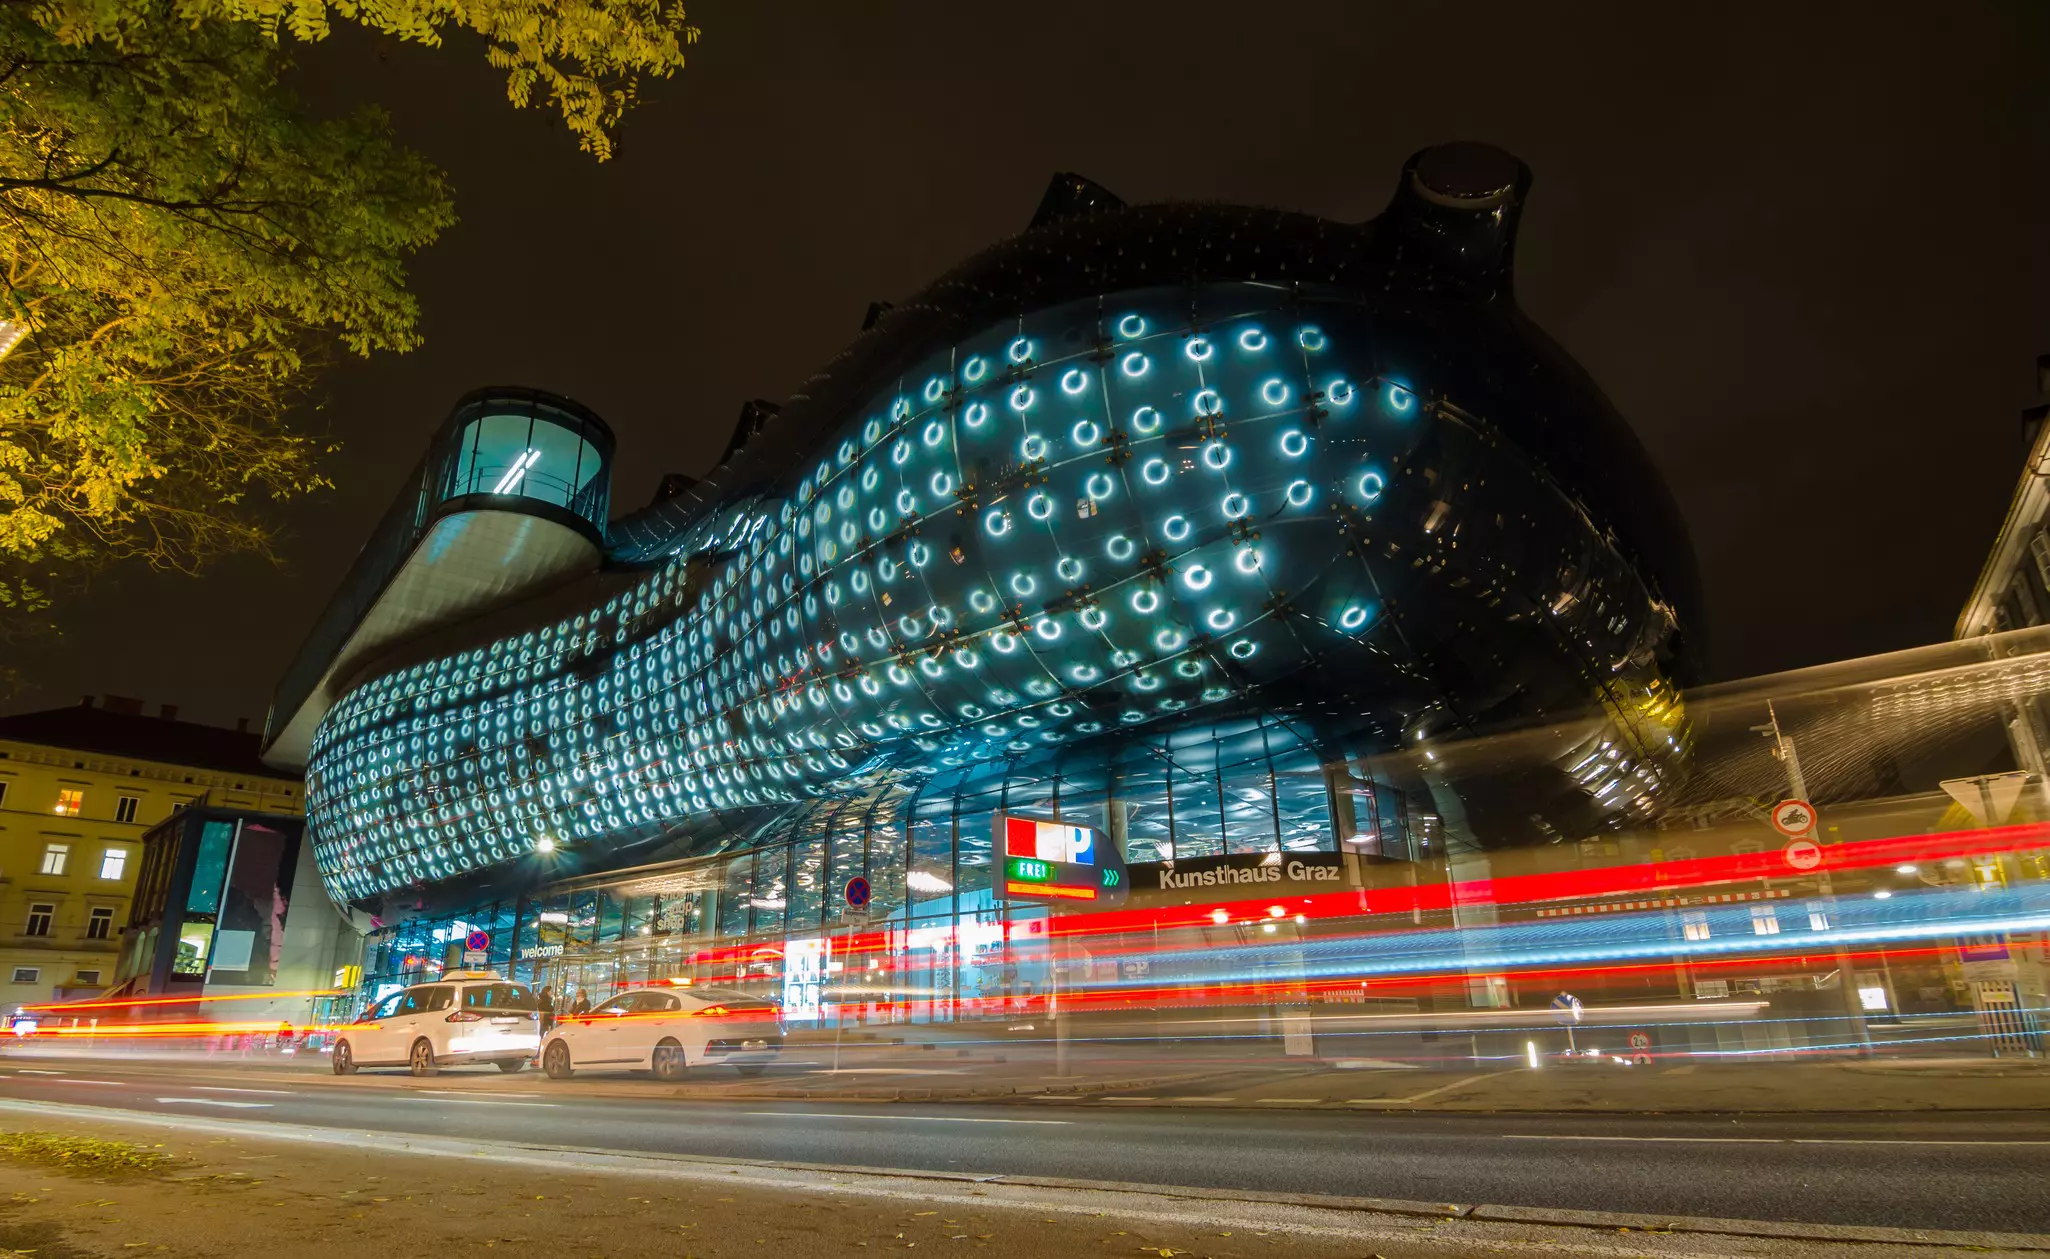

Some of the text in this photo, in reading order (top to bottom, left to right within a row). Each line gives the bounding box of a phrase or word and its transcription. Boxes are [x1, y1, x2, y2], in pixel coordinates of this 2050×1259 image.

[1019, 862, 1046, 878] FREI
[1159, 860, 1340, 890] Kunsthaus Graz
[521, 944, 564, 959] welcome
